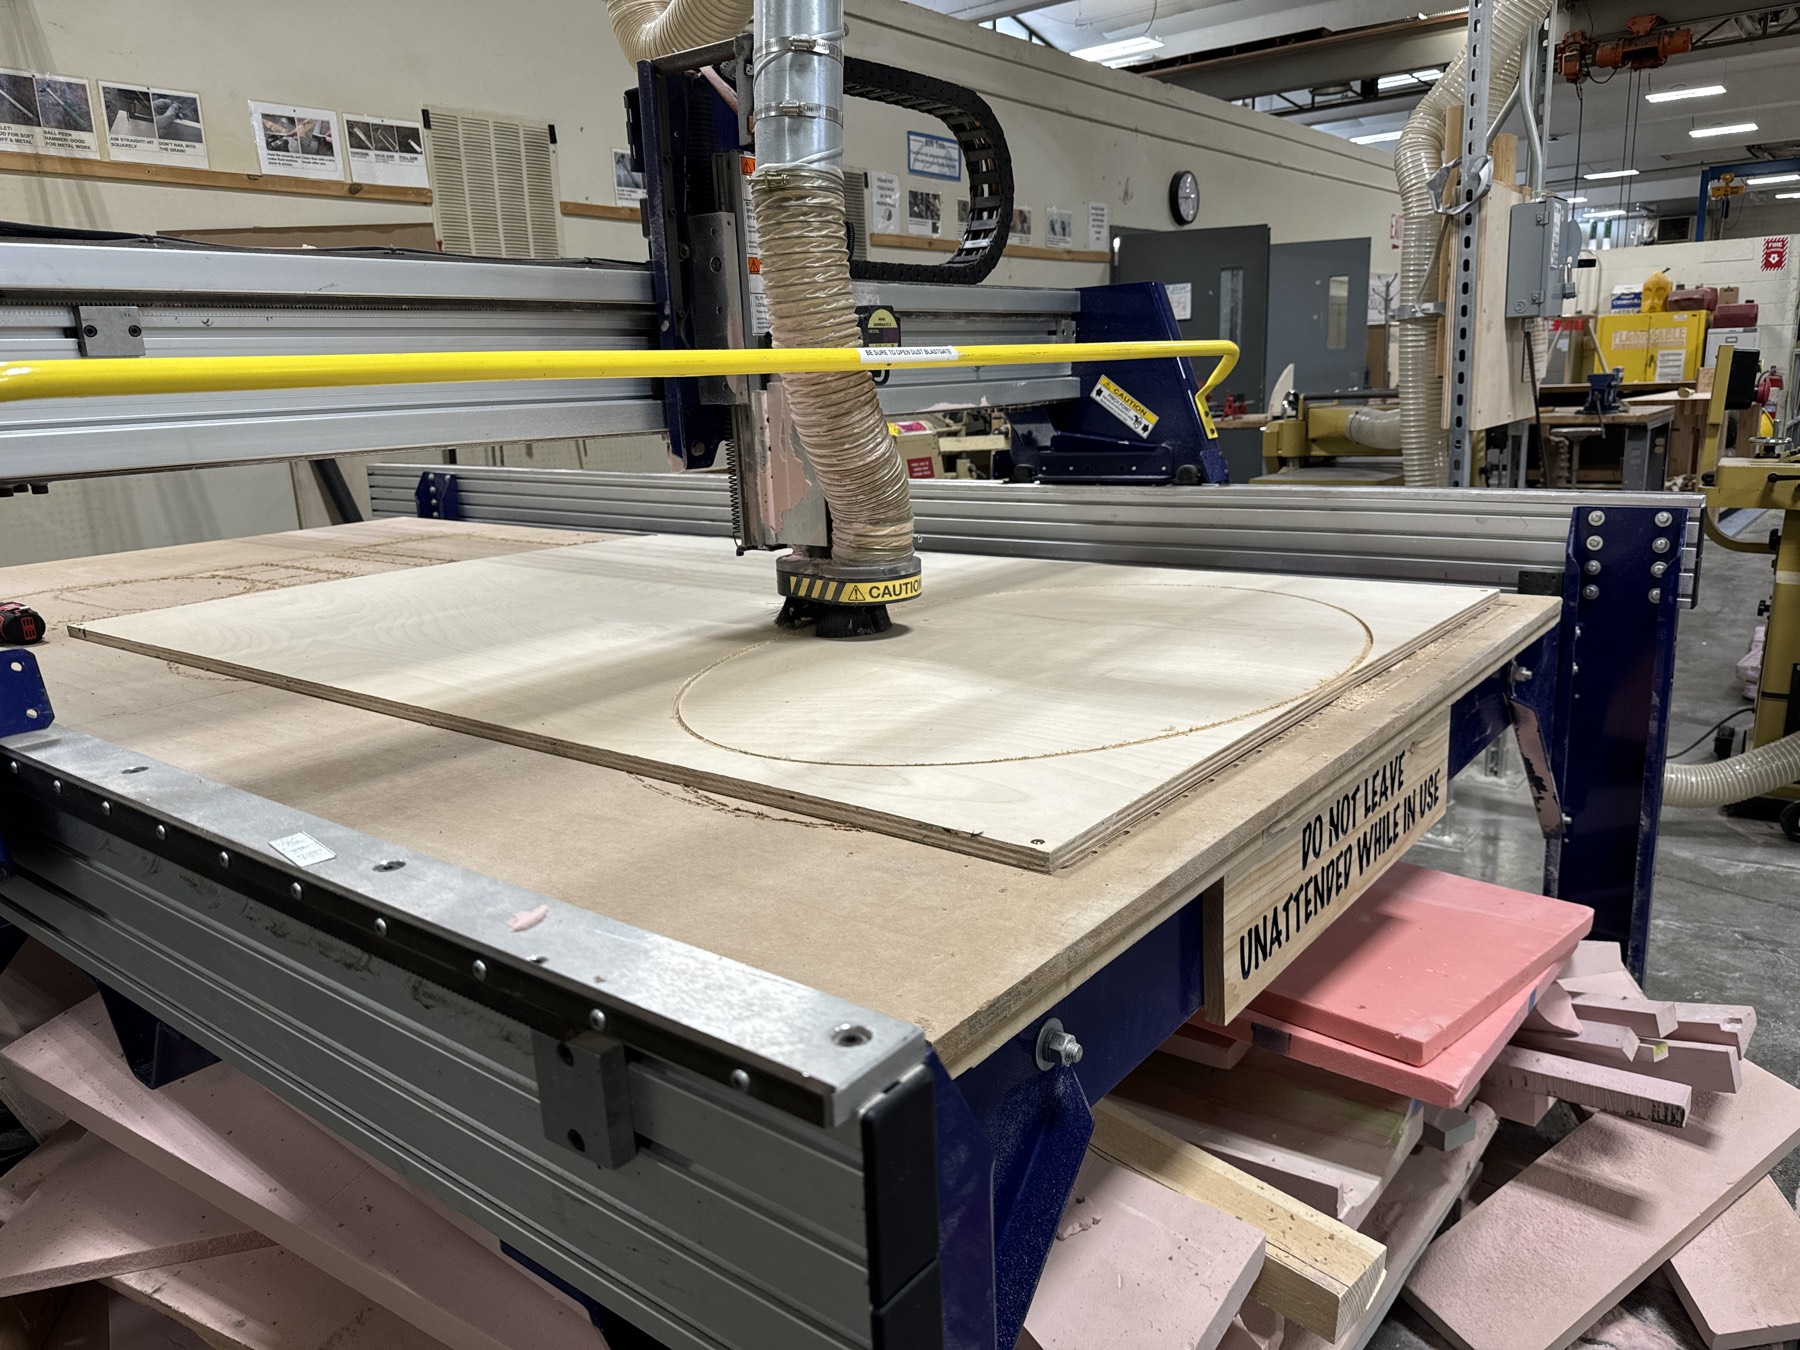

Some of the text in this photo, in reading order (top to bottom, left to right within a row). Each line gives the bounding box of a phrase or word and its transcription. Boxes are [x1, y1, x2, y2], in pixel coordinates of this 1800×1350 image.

[1113, 388, 1147, 416] CAUTION
[1301, 750, 1405, 871] DO NOT LEAVE
[1240, 768, 1441, 980] UNATTENDED WHILE IN USE
